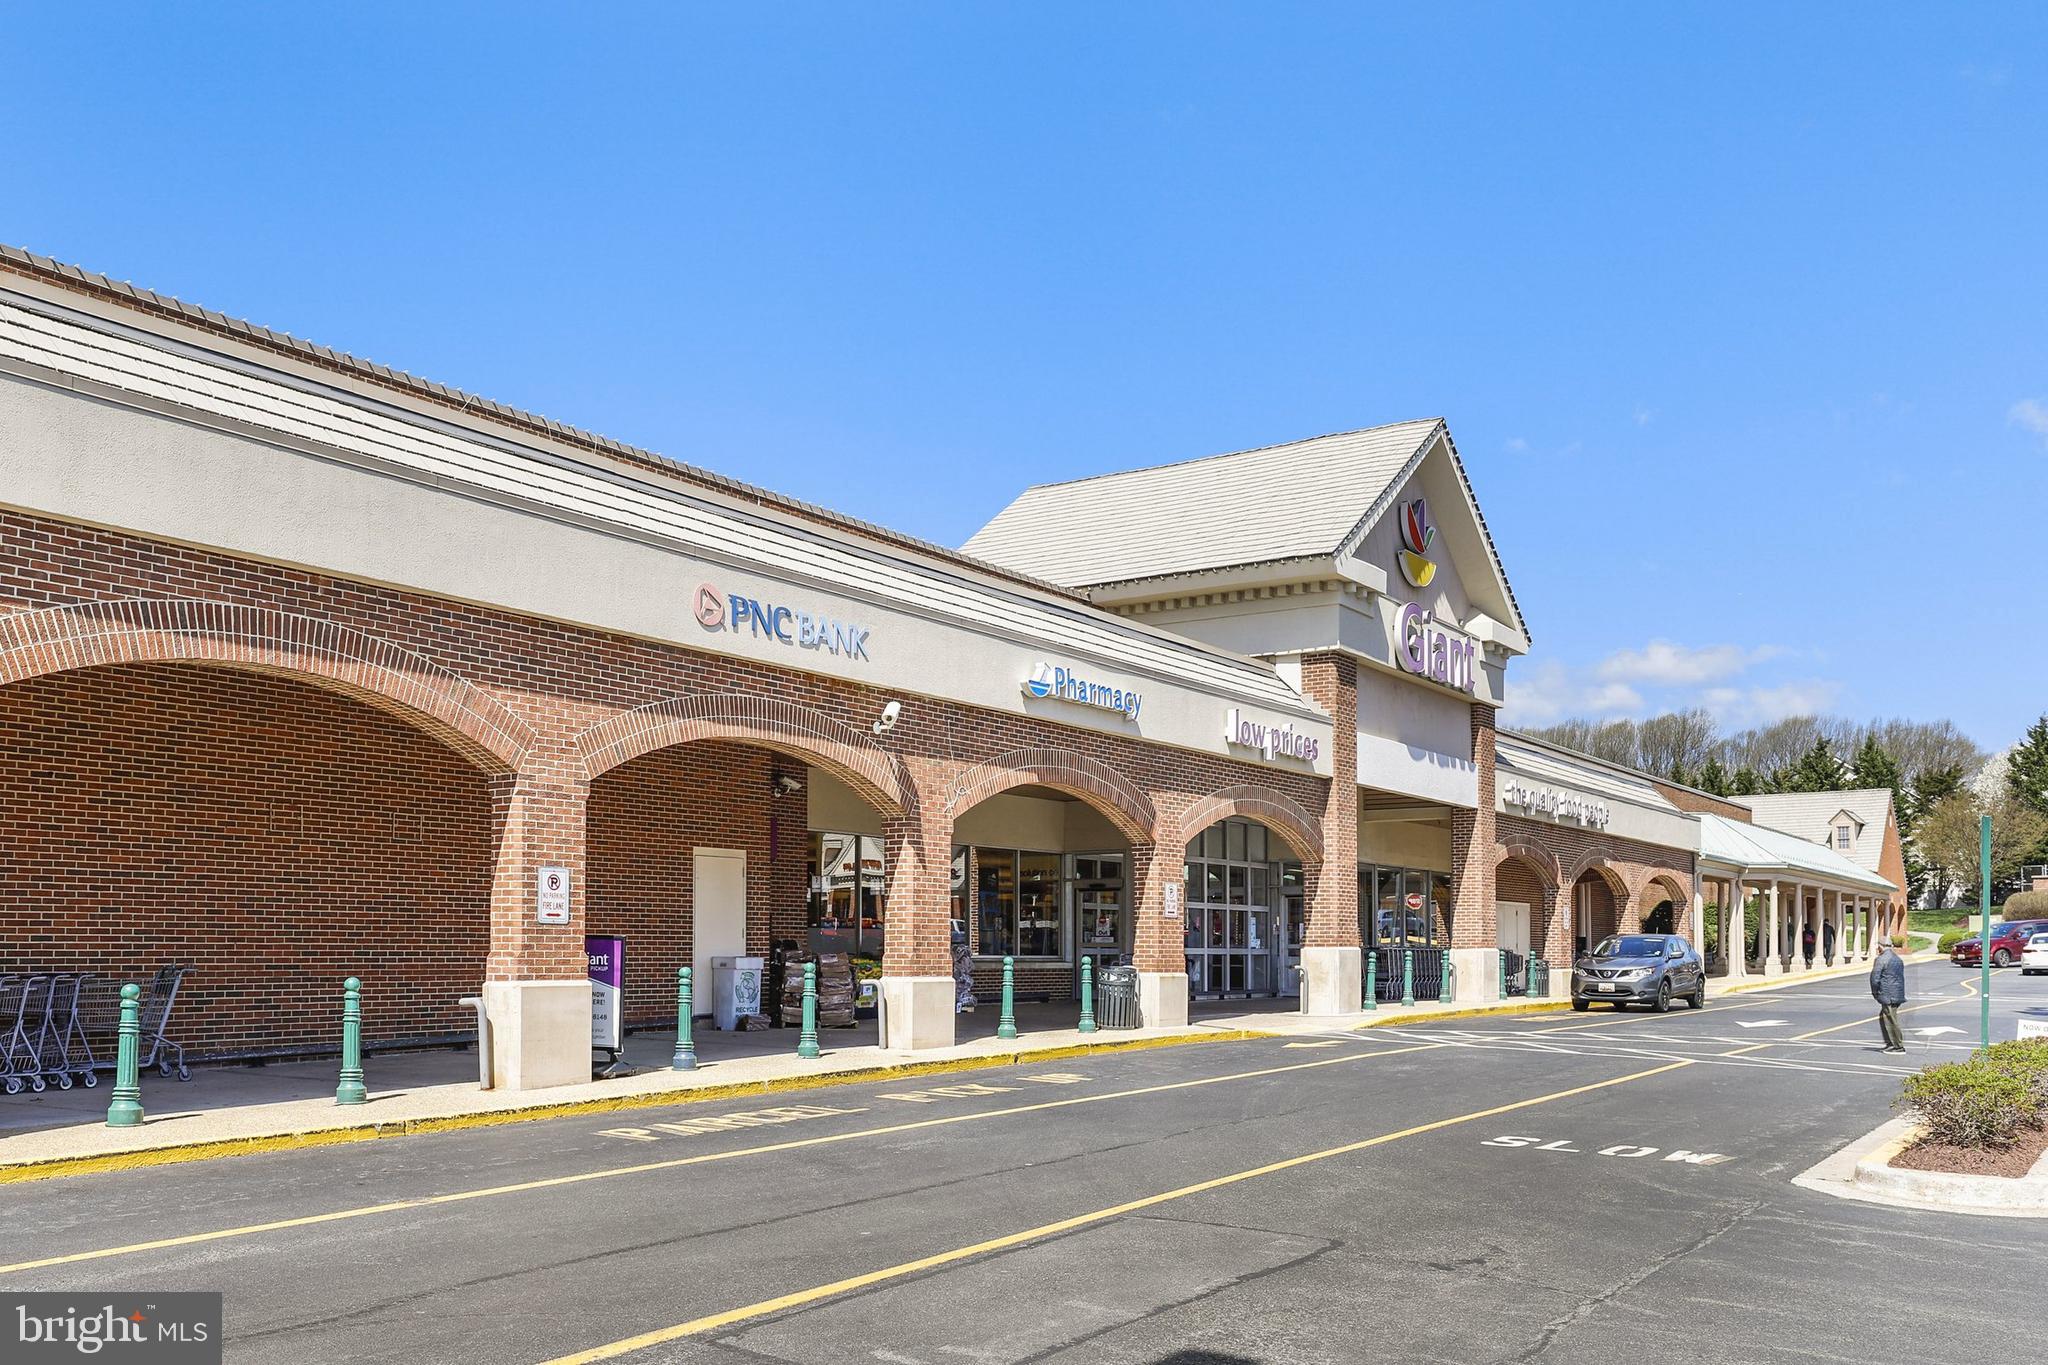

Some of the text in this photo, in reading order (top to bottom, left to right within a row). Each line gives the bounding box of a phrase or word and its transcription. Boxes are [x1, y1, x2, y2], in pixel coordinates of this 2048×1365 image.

[728, 594, 869, 662] PNC BANK
[1395, 602, 1475, 692] Giant
[1055, 667, 1142, 719] Pharmacy
[1229, 709, 1319, 761] low prices
[1506, 780, 1527, 806] the
[1529, 788, 1560, 822] quality
[1583, 801, 1611, 828] people
[543, 902, 552, 910] FIRE
[875, 1083, 1024, 1103] PICK
[1016, 1073, 1094, 1084] UP
[1480, 1135, 1738, 1166] SLOW
